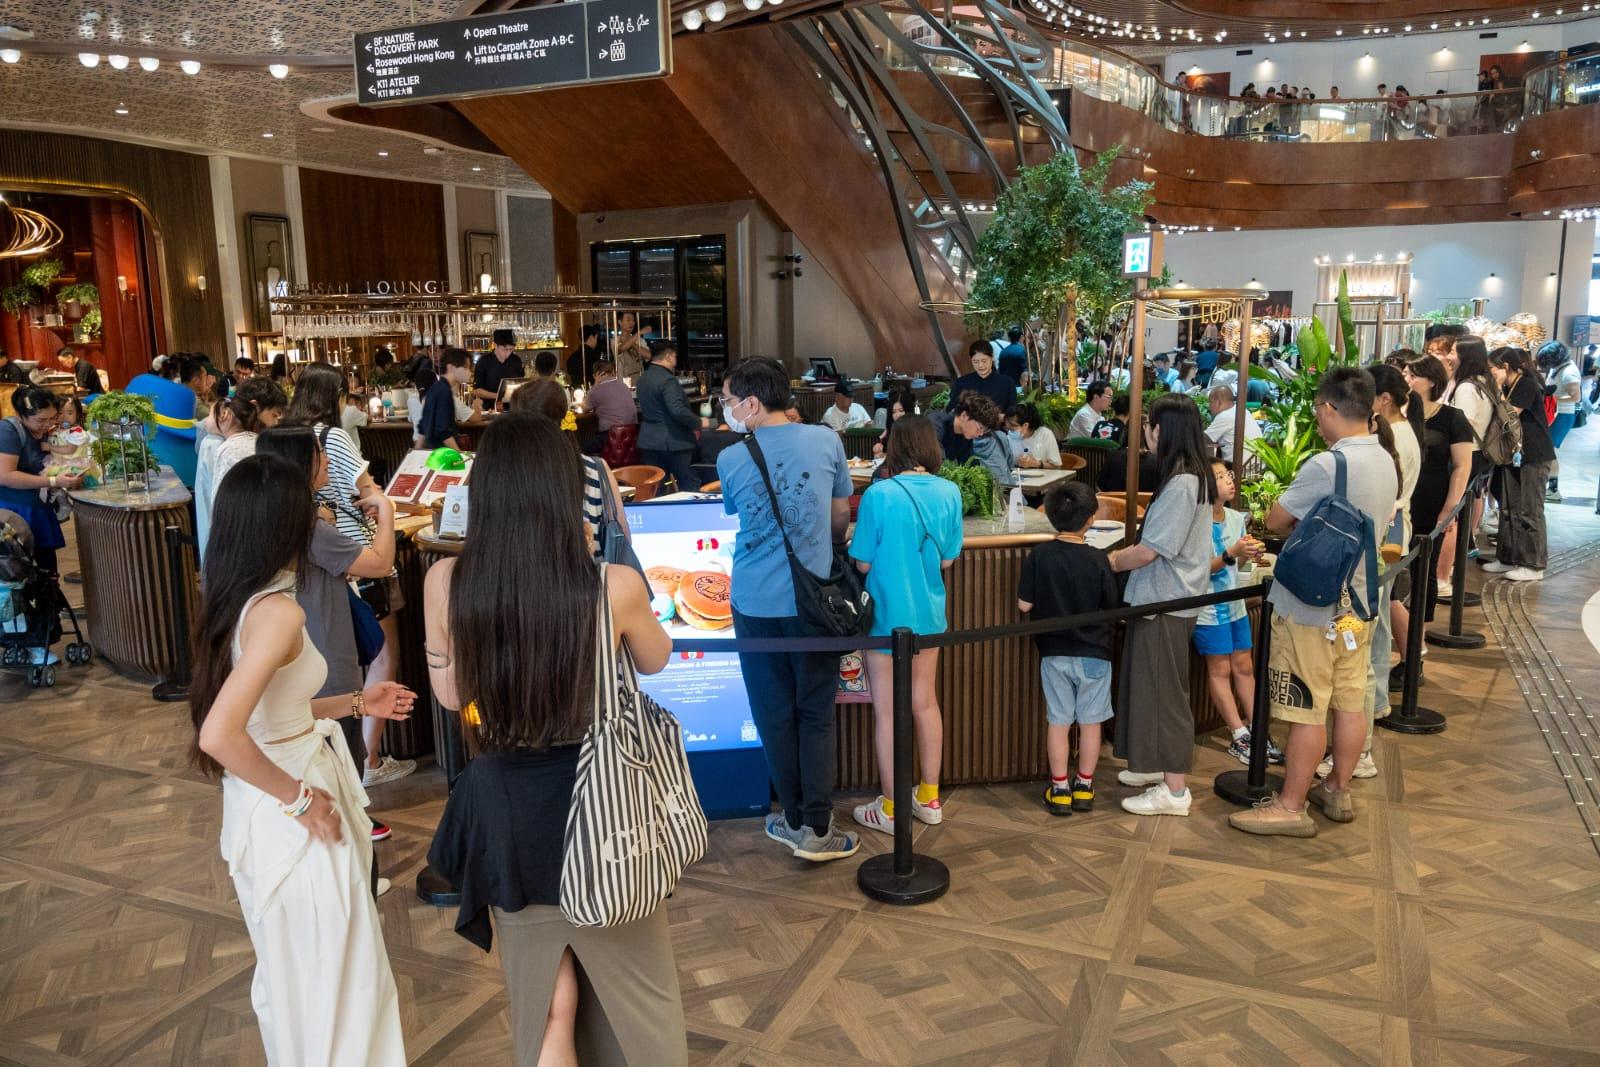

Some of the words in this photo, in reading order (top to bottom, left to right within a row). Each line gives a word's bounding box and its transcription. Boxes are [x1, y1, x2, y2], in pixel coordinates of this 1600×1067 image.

[473, 27, 497, 39] Opera
[498, 23, 529, 35] Theatre
[373, 36, 383, 47] 8F
[384, 32, 415, 45] NATURE
[374, 41, 416, 56] DISCOVERY
[417, 38, 439, 50] PARK
[473, 45, 488, 56] Lift
[488, 44, 497, 54] to
[497, 40, 528, 53] Carpark
[529, 38, 549, 49] Zone
[375, 53, 412, 68] Rosewood
[413, 52, 434, 63] Hong
[434, 50, 455, 60] Kong
[376, 79, 389, 89] K11
[389, 75, 420, 87] ATELIER
[377, 88, 389, 98] K11
